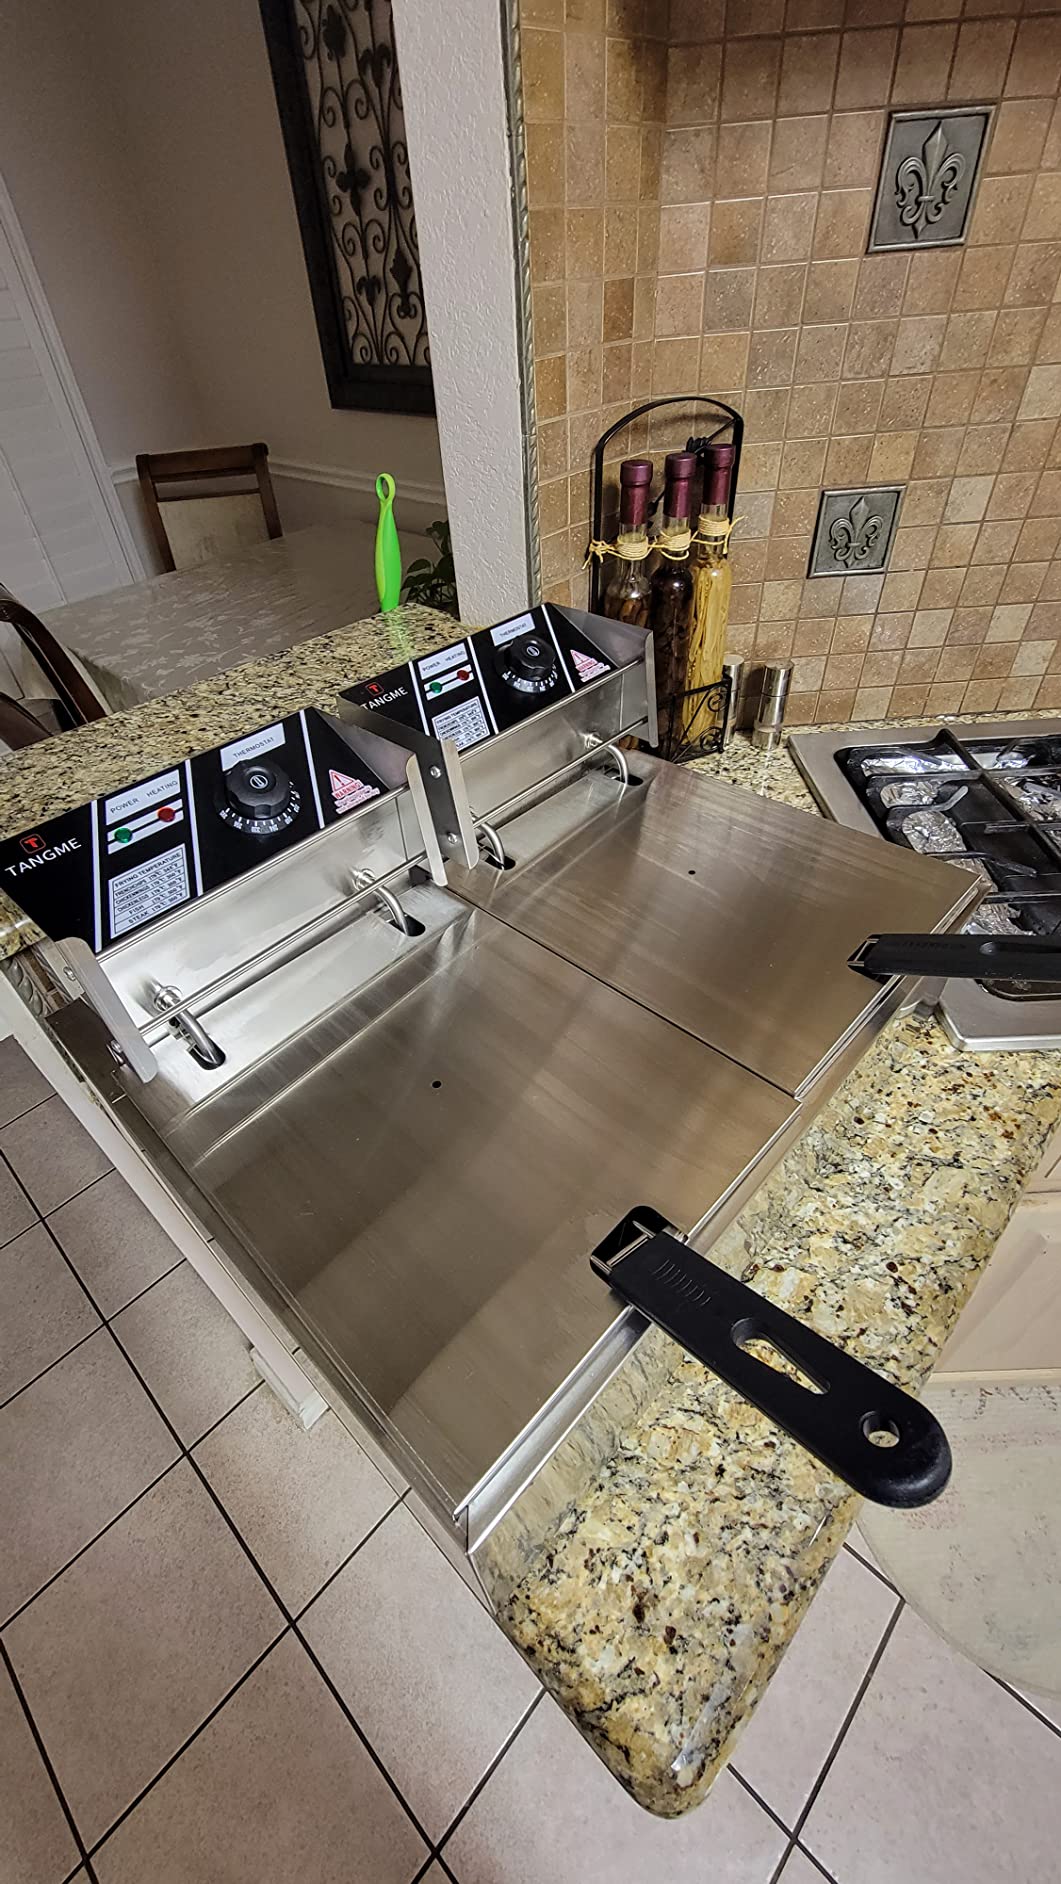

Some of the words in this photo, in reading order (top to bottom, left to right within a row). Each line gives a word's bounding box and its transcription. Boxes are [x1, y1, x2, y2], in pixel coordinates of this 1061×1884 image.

[360, 686, 409, 710] TANGME
[233, 737, 274, 758] THERMOSTAT
[110, 798, 140, 813] POWER
[146, 780, 178, 797] HEATING
[4, 837, 82, 876] TANGME
[114, 873, 139, 888] FRYING
[138, 852, 181, 876] TEMPERATURE
[128, 904, 145, 915] FISH
[128, 910, 149, 924] STEAK
